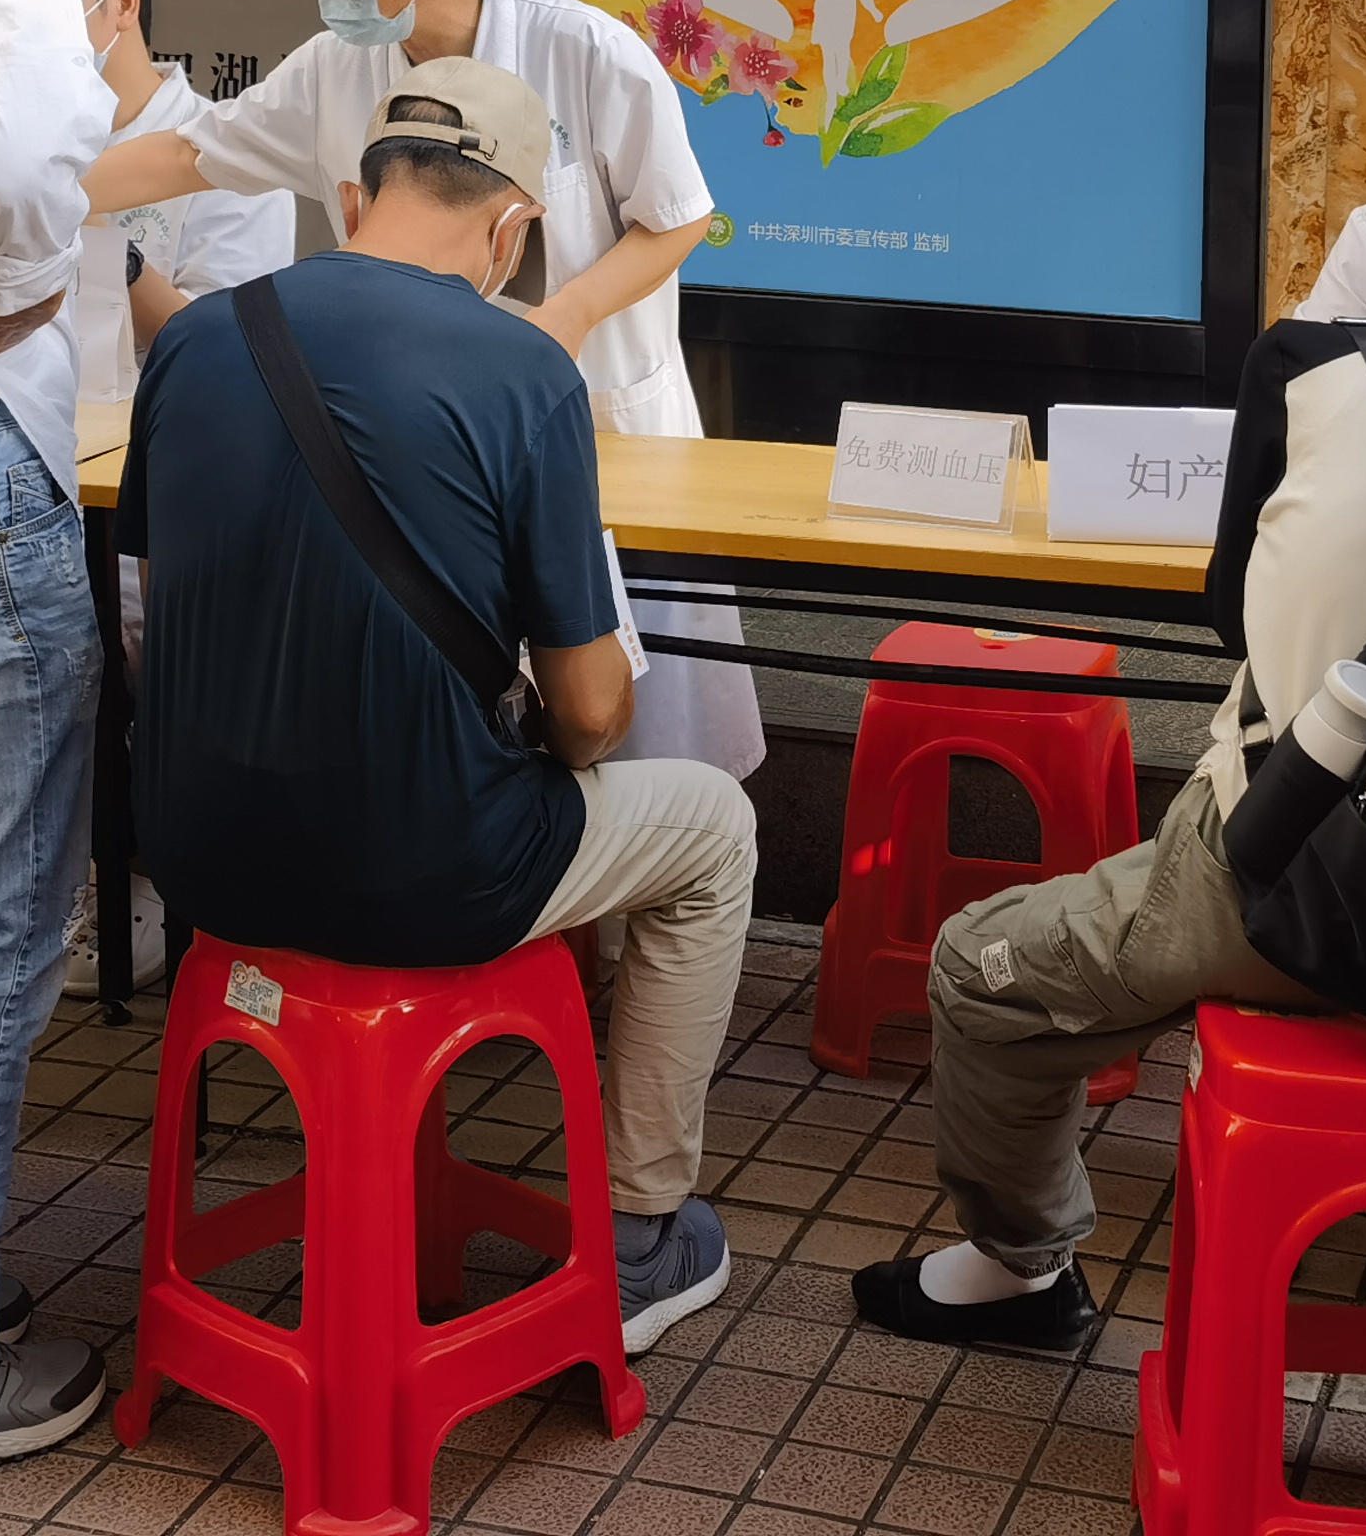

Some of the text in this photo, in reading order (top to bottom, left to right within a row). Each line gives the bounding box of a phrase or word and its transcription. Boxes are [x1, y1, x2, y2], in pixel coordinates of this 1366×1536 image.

[747, 221, 908, 250] 中共深圳市委宣传部
[912, 232, 950, 253] 监制
[841, 434, 1004, 486] 免费测血压
[1126, 452, 1224, 501] 妇产
